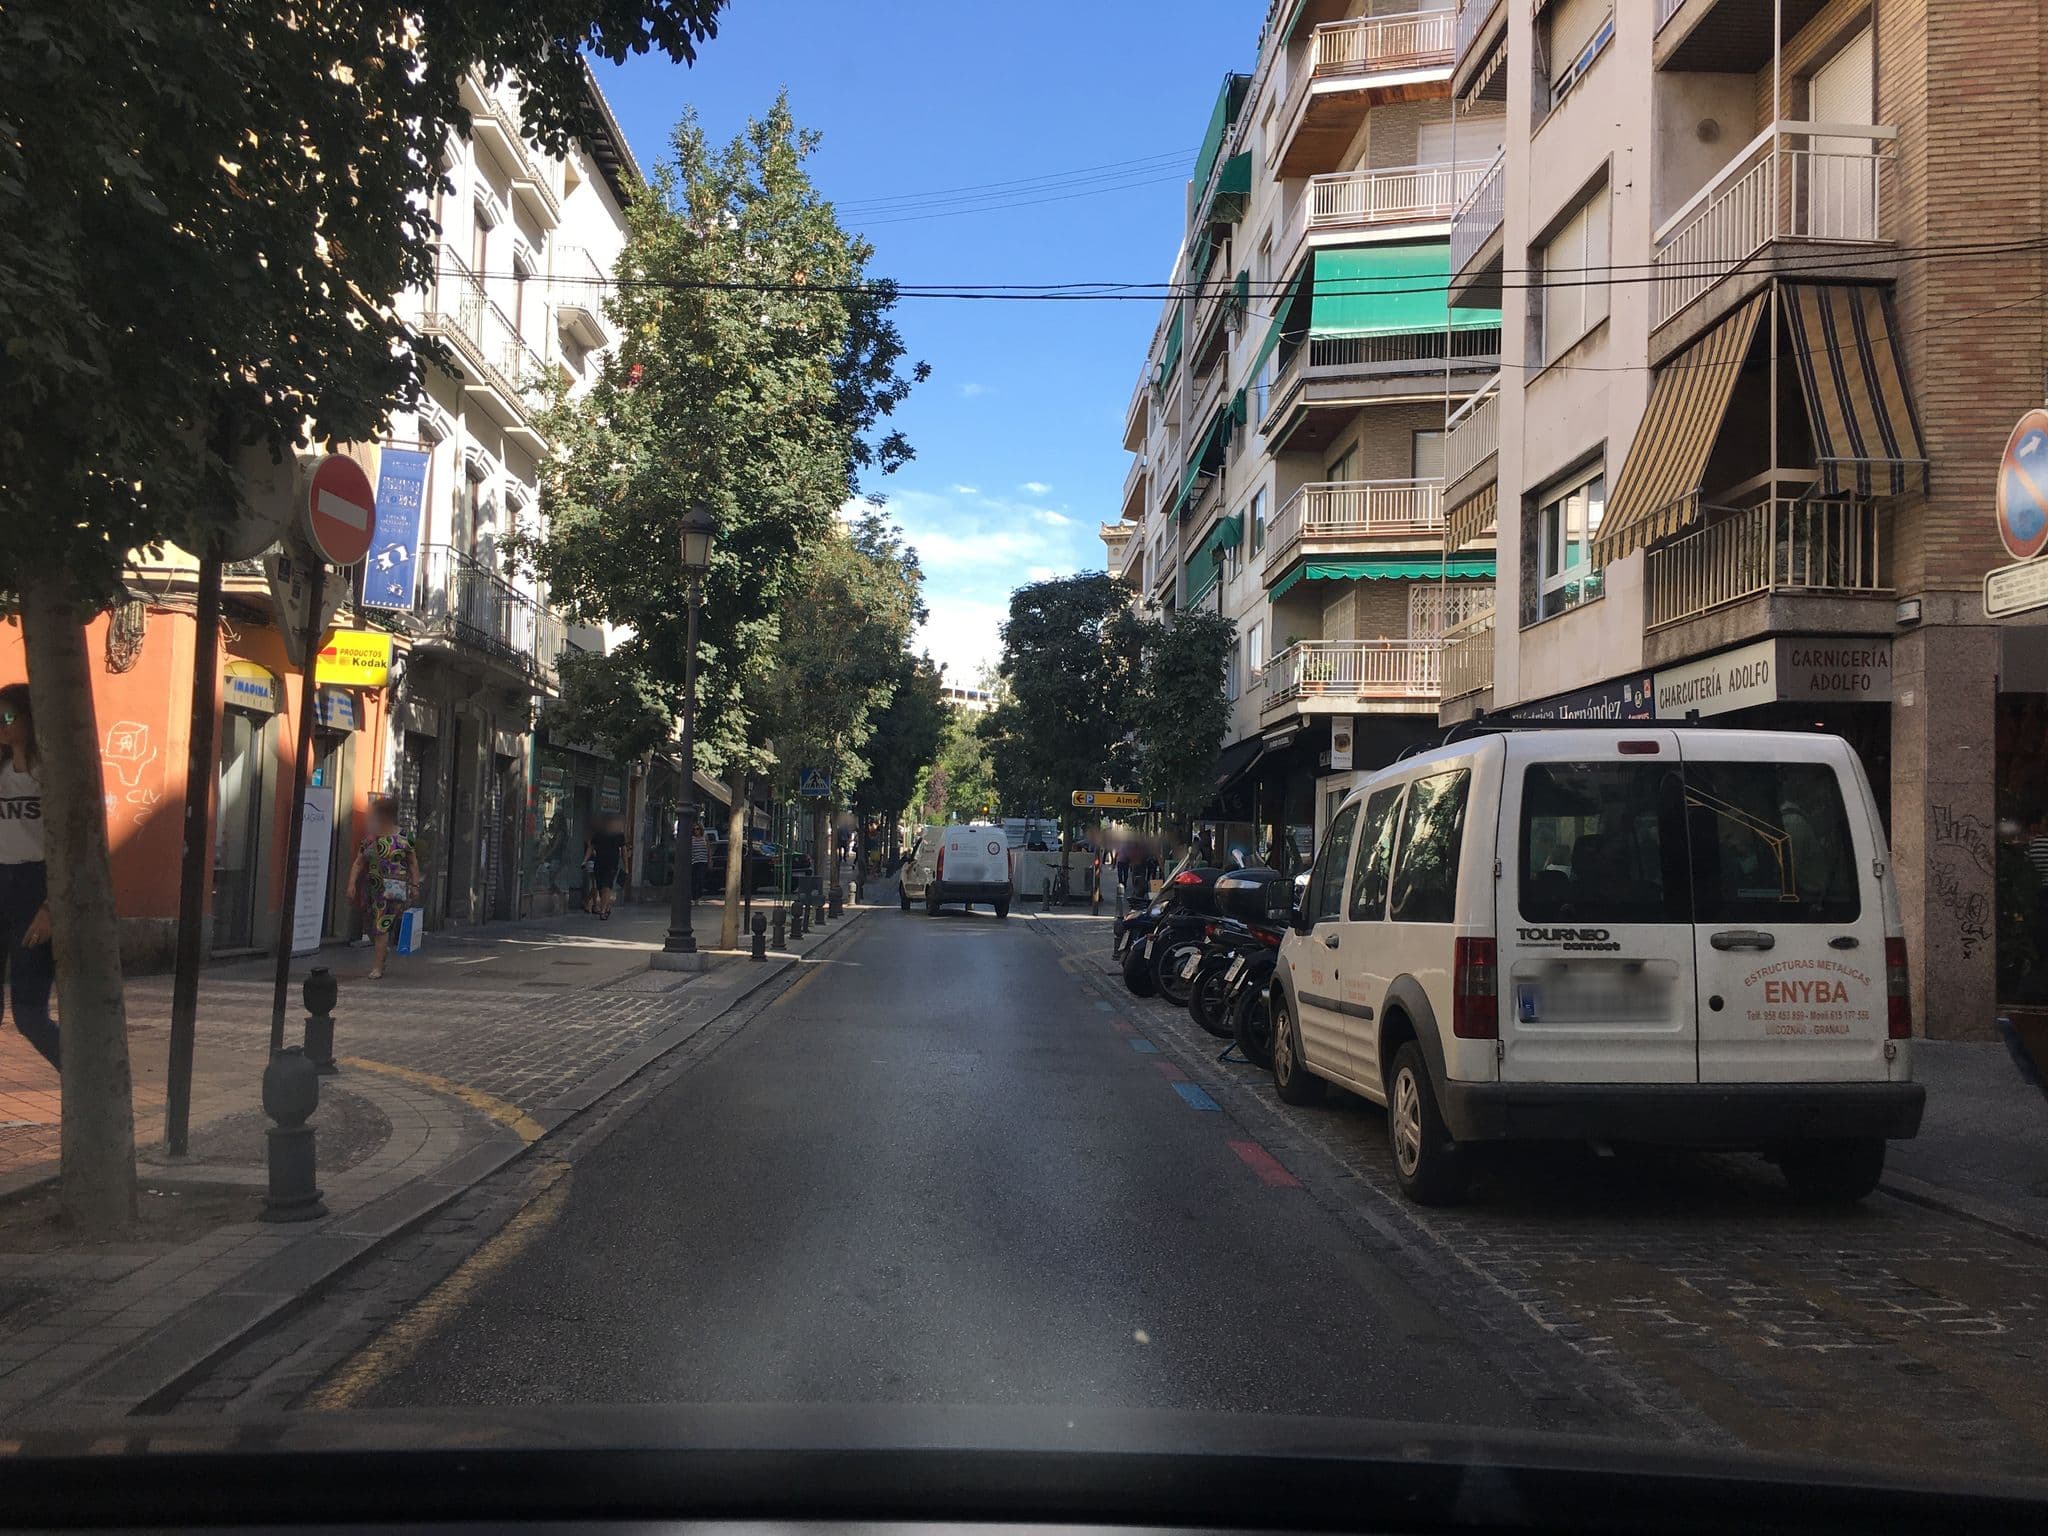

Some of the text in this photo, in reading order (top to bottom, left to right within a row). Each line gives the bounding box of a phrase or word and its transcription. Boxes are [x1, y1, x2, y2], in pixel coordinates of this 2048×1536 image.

[339, 648, 383, 658] PRODUCTOS
[1791, 646, 1889, 669] CARNICERÍA
[352, 657, 388, 668] Kodak
[1659, 659, 1770, 710] CHARCUTERÍA ADOLFO
[1810, 673, 1872, 691] ADOLFO
[1516, 928, 1610, 941] TOURNEO
[1744, 959, 1872, 987] ESTRUCTURAS METALICAS
[1764, 980, 1849, 1004] ENYBA
[1813, 1024, 1850, 1035] GRANADA
